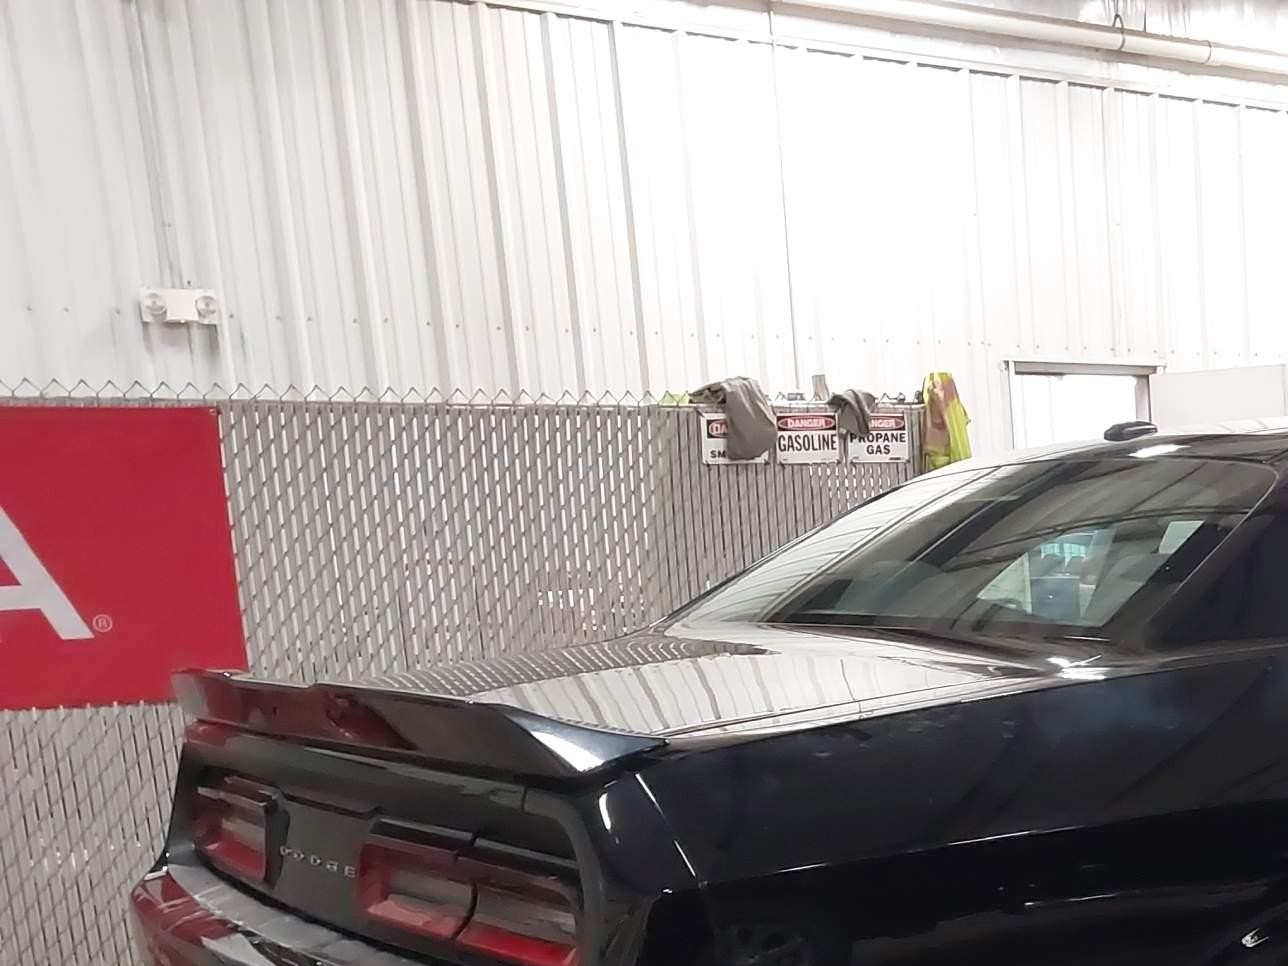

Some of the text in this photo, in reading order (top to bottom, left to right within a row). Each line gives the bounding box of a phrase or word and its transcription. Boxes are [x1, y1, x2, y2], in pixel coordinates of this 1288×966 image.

[786, 418, 826, 428] DANGER
[868, 418, 896, 429] NGER
[778, 433, 837, 452] GASOLINE
[710, 449, 727, 459] SM
[866, 444, 891, 455] GAS
[279, 845, 357, 878] DODGE
